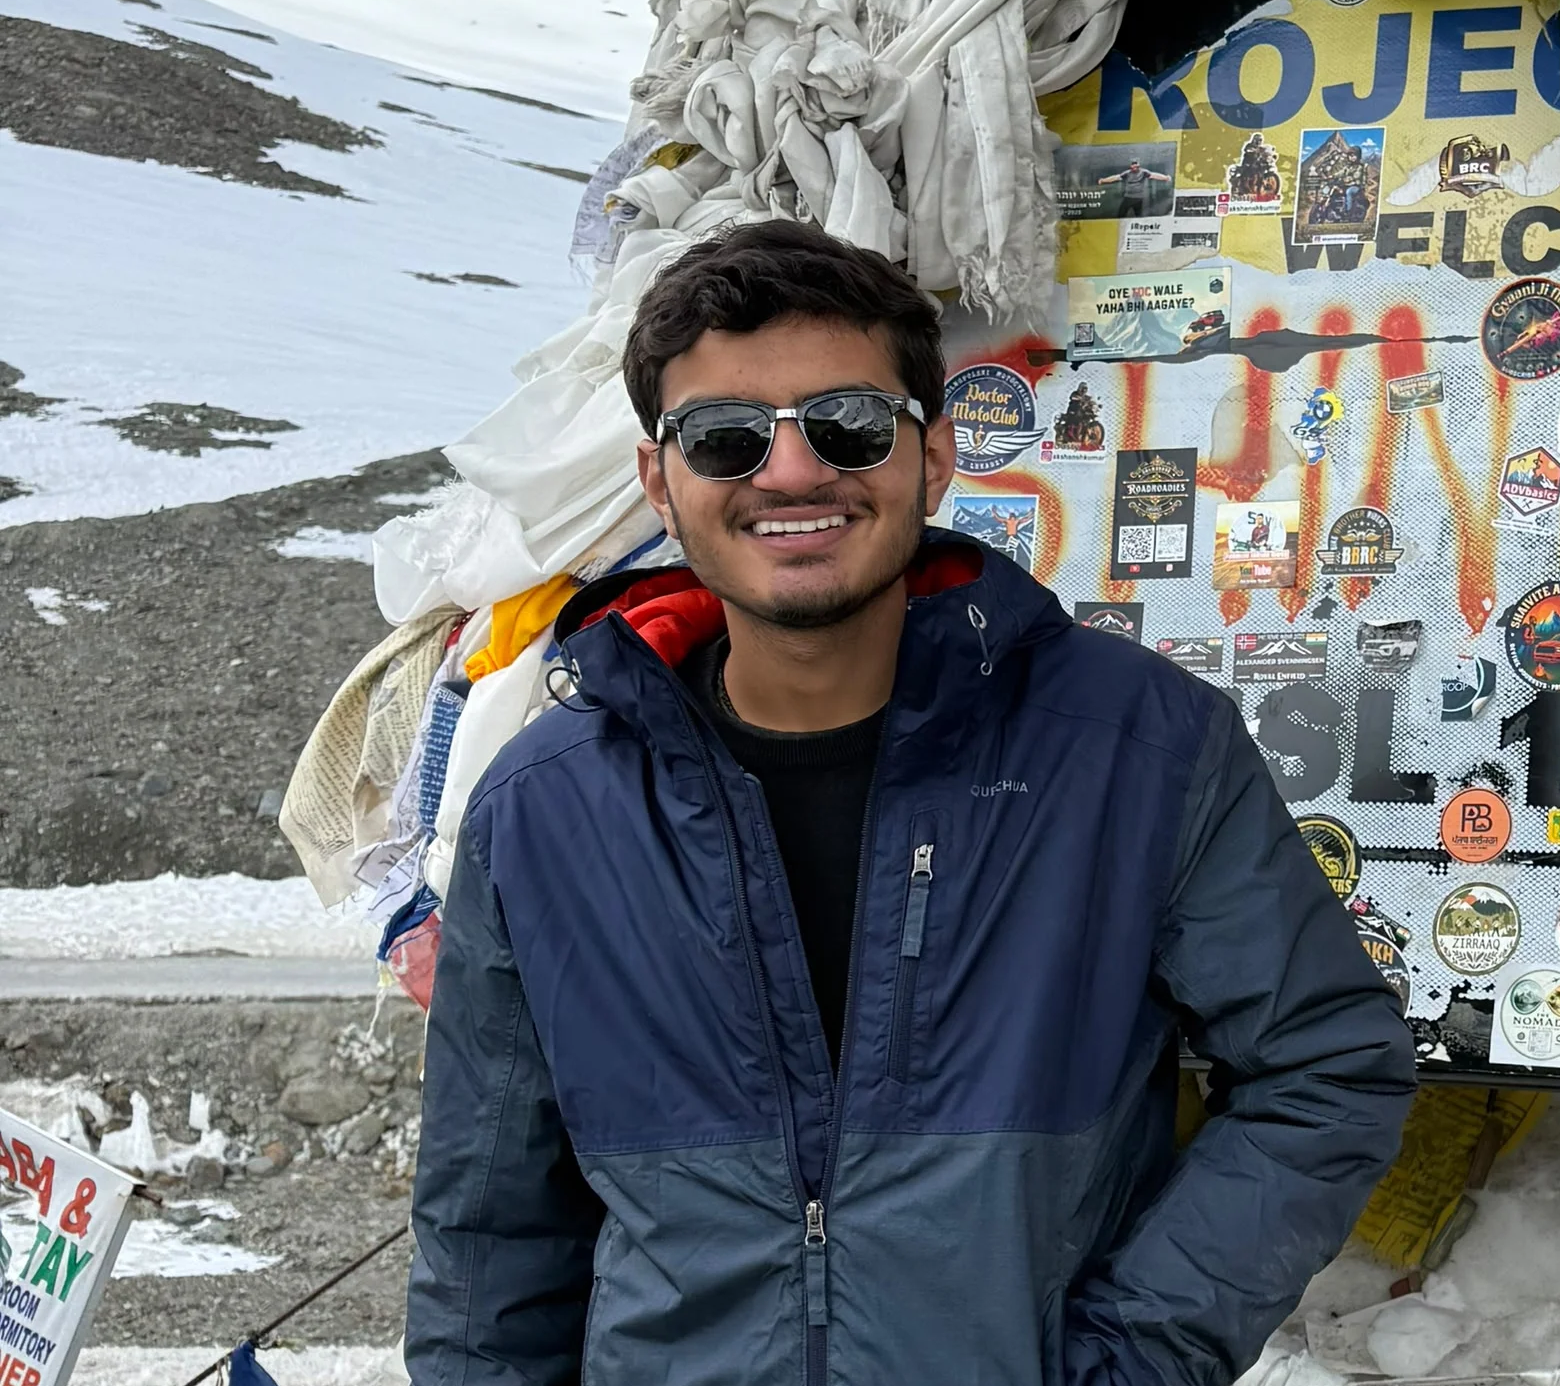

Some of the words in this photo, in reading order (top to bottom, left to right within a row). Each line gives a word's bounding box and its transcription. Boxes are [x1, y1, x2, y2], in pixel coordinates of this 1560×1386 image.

[1459, 162, 1490, 175] BRC
[1108, 287, 1129, 300] OYE
[1153, 284, 1183, 296] WALE
[1097, 302, 1125, 315] YAHA
[1127, 300, 1145, 313] BHI
[1147, 297, 1195, 312] AAGAYE?
[965, 383, 1013, 405] Doctor
[951, 401, 1020, 427] MotoClub
[1341, 546, 1378, 565] BBRC
[1511, 585, 1551, 629] SHAIVITE
[970, 779, 1029, 798] QUECHUA
[1451, 937, 1502, 951] ZIRRAAQ
[59, 1177, 97, 1239] &
